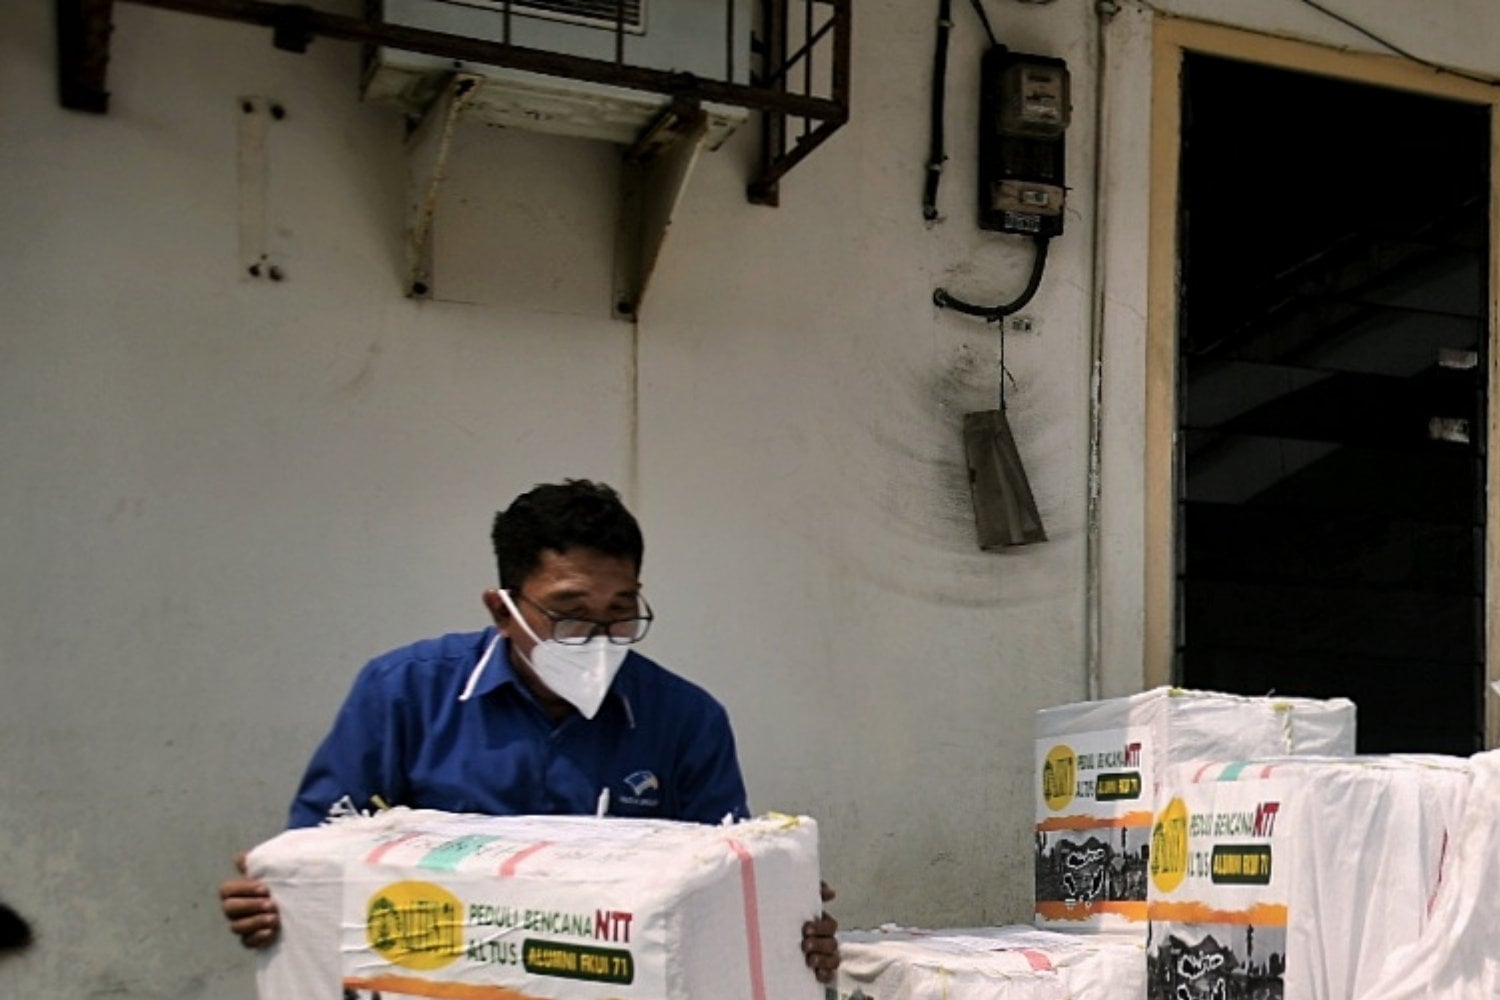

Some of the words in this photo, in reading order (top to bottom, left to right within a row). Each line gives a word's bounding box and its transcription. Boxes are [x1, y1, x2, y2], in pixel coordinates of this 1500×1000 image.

[1252, 802, 1280, 838] NTT
[467, 903, 518, 930] PEDULI
[523, 908, 593, 936] BENCANA
[594, 908, 634, 944] NTT
[466, 939, 518, 966] ALTUS
[611, 956, 630, 978] 71
